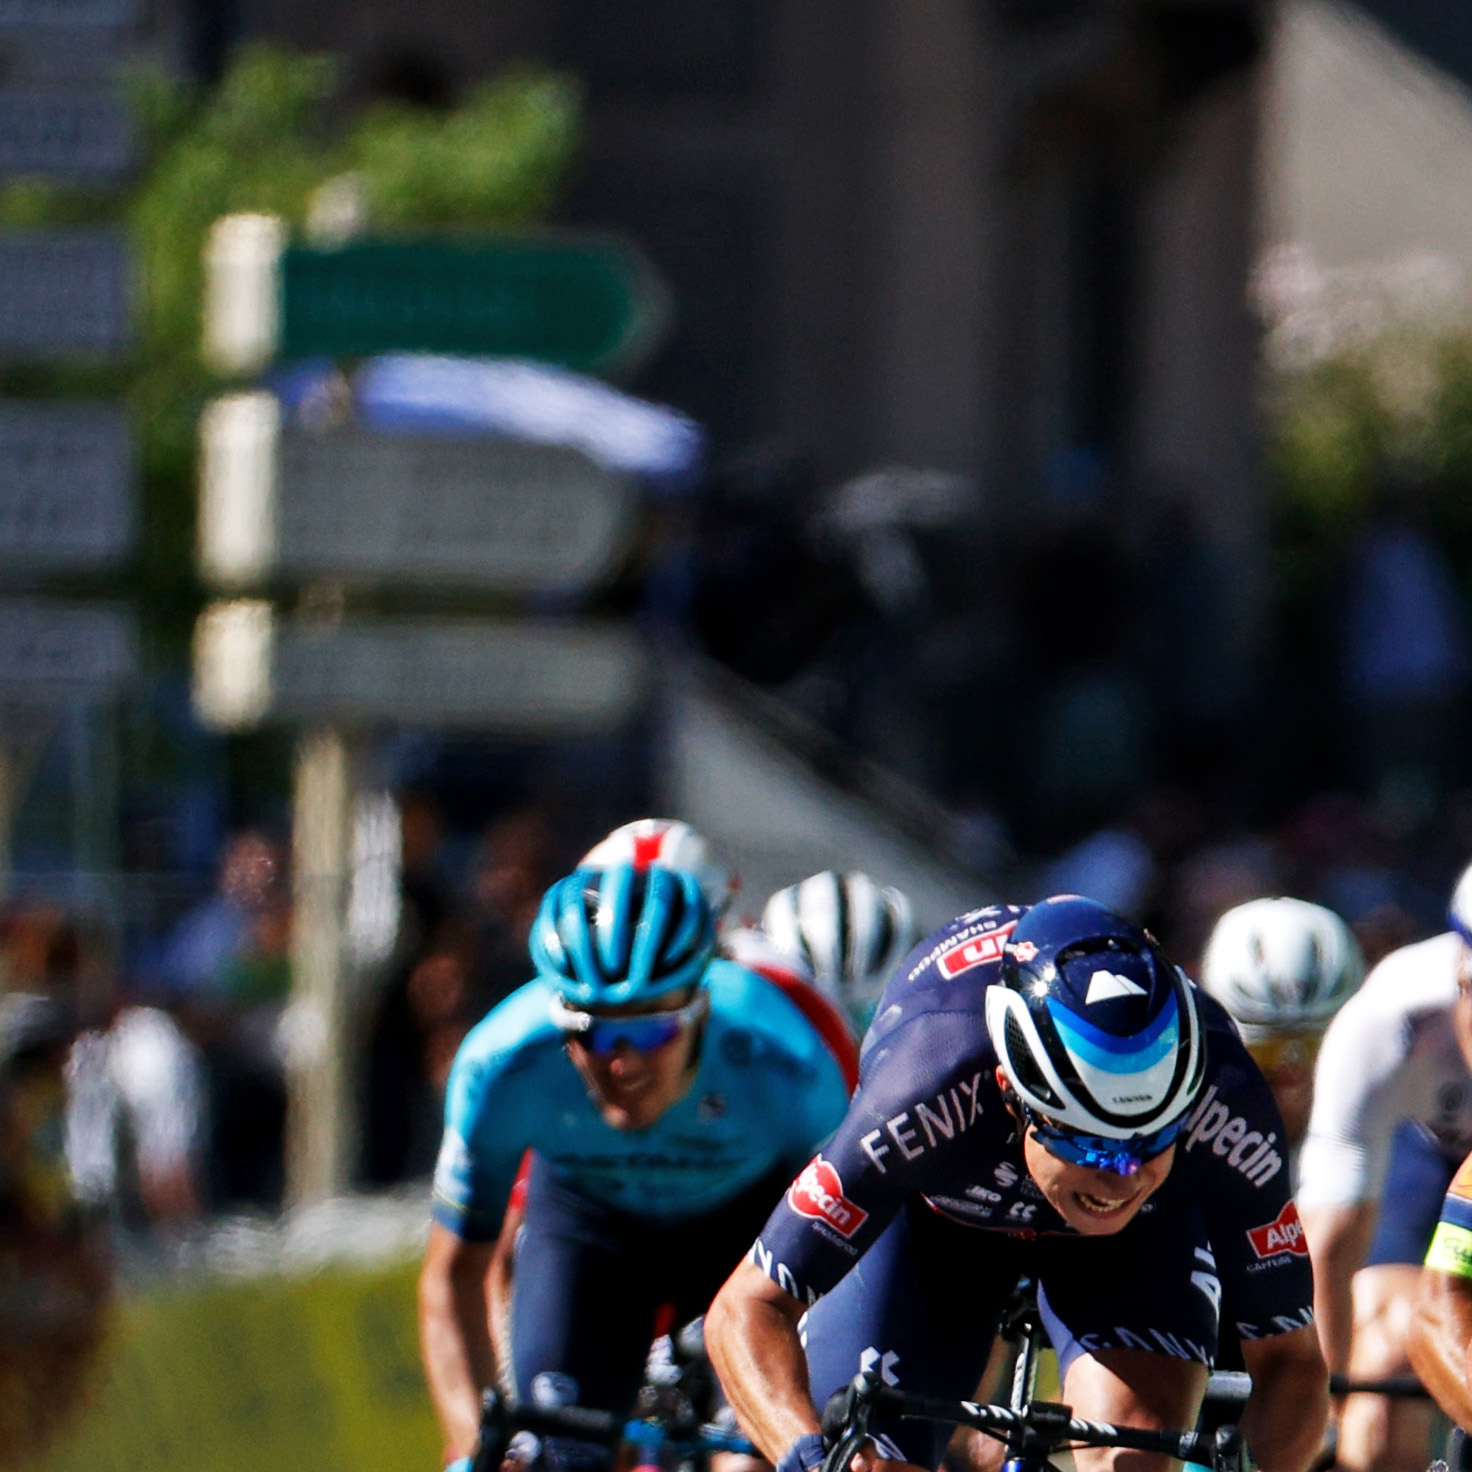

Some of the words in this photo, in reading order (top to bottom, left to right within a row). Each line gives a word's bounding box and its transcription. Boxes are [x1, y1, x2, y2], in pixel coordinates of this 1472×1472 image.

[860, 1071, 984, 1174] FENIX
[1185, 1084, 1272, 1189] lpecin
[797, 1162, 850, 1225] lpecin
